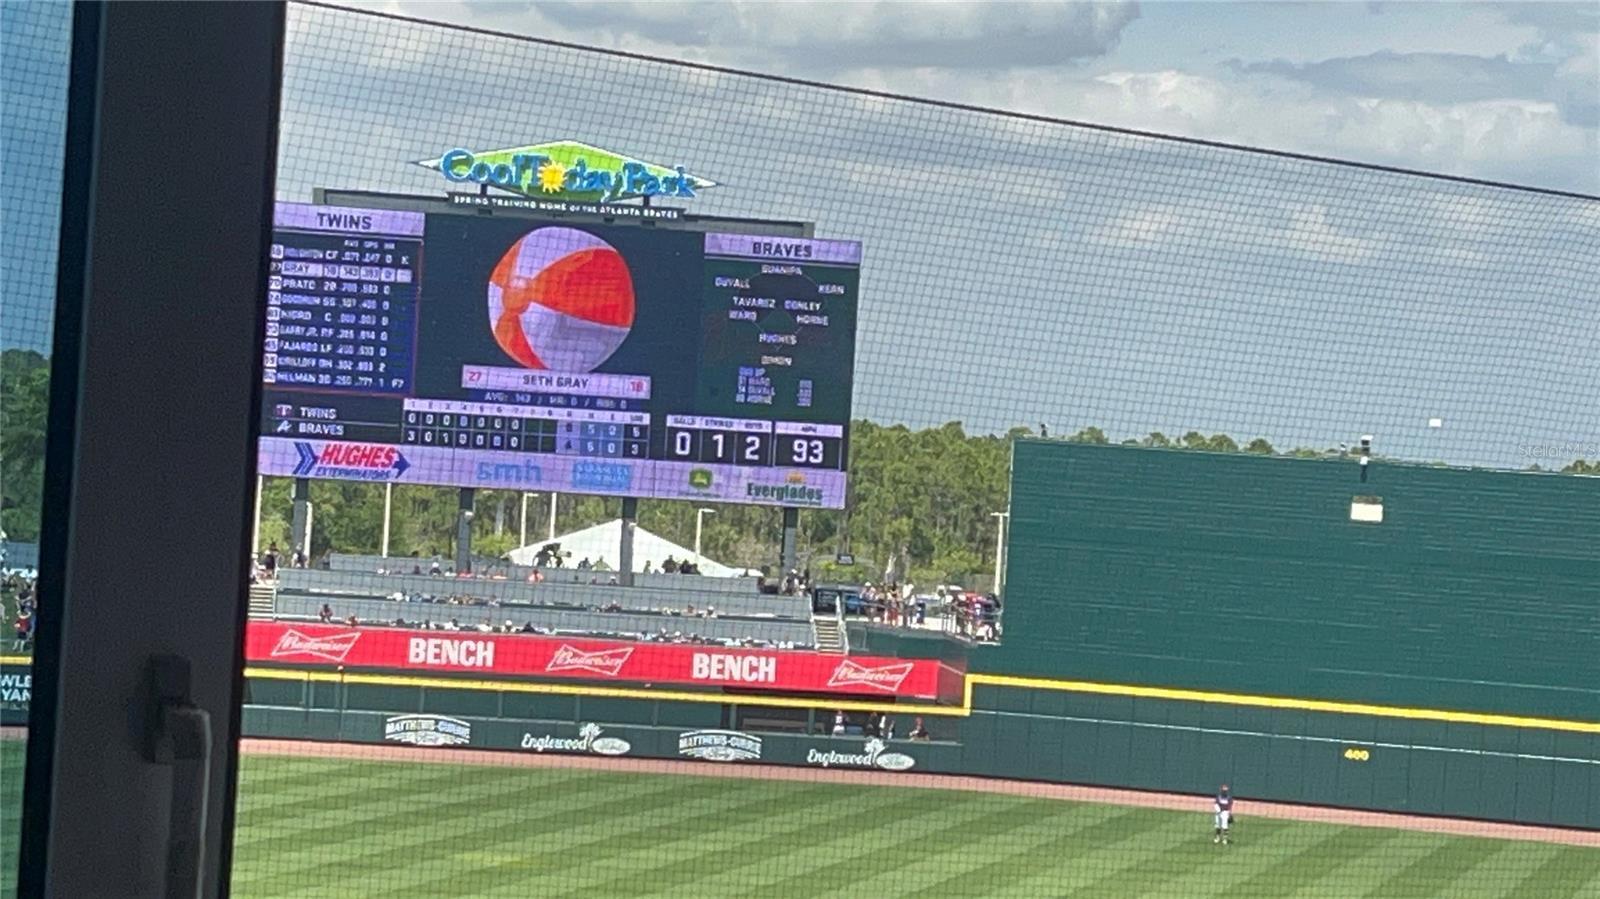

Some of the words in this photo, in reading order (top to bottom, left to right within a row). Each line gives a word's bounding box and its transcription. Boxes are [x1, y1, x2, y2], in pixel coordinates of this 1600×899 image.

[621, 161, 696, 198] Park
[454, 196, 489, 206] SPRING
[492, 198, 537, 209] TRAINING
[539, 201, 567, 211] HOME
[599, 206, 641, 217] ATLANTA
[317, 212, 372, 230] TWINS
[752, 242, 812, 257] BRAVES
[325, 312, 332, 322] C
[468, 371, 482, 382] 27
[522, 374, 554, 386] SETH
[556, 376, 590, 389] GRAY
[300, 407, 337, 420] TWINS
[408, 414, 416, 424] 0
[426, 415, 434, 424] 0
[443, 415, 451, 425] 0
[299, 422, 344, 436] BRAVES
[407, 430, 415, 441] 3
[443, 432, 449, 443] 1
[510, 437, 518, 448] 0
[608, 442, 615, 454] 0
[632, 444, 639, 455] 3
[675, 431, 691, 455] 0
[713, 433, 724, 458] 1
[745, 436, 760, 460] 2
[792, 439, 824, 464] 93
[319, 444, 396, 468] HUGHES
[477, 459, 541, 482] smh
[747, 482, 823, 501] Everglades
[281, 636, 351, 651] Budweiser
[408, 637, 495, 667] BENCH
[556, 650, 622, 667] Budweiser
[692, 652, 776, 682] BENCH
[835, 666, 906, 682] Budweiser
[521, 733, 587, 752] Englewood
[807, 748, 872, 767] Englewood
[1344, 749, 1369, 761] 400
